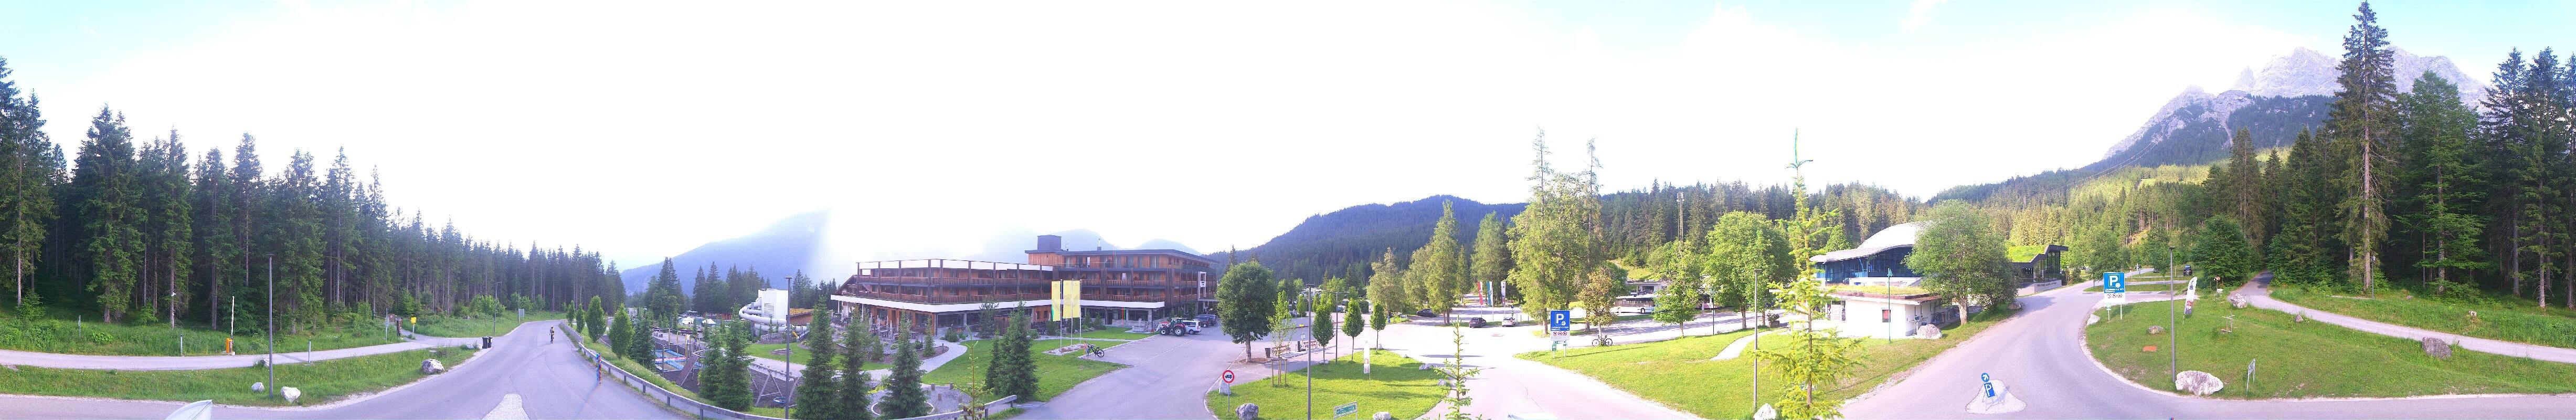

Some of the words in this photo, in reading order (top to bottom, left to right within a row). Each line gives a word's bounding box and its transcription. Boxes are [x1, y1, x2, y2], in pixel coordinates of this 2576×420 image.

[2109, 276, 2118, 286] P
[1556, 313, 1564, 324] P
[1985, 384, 1992, 397] P
